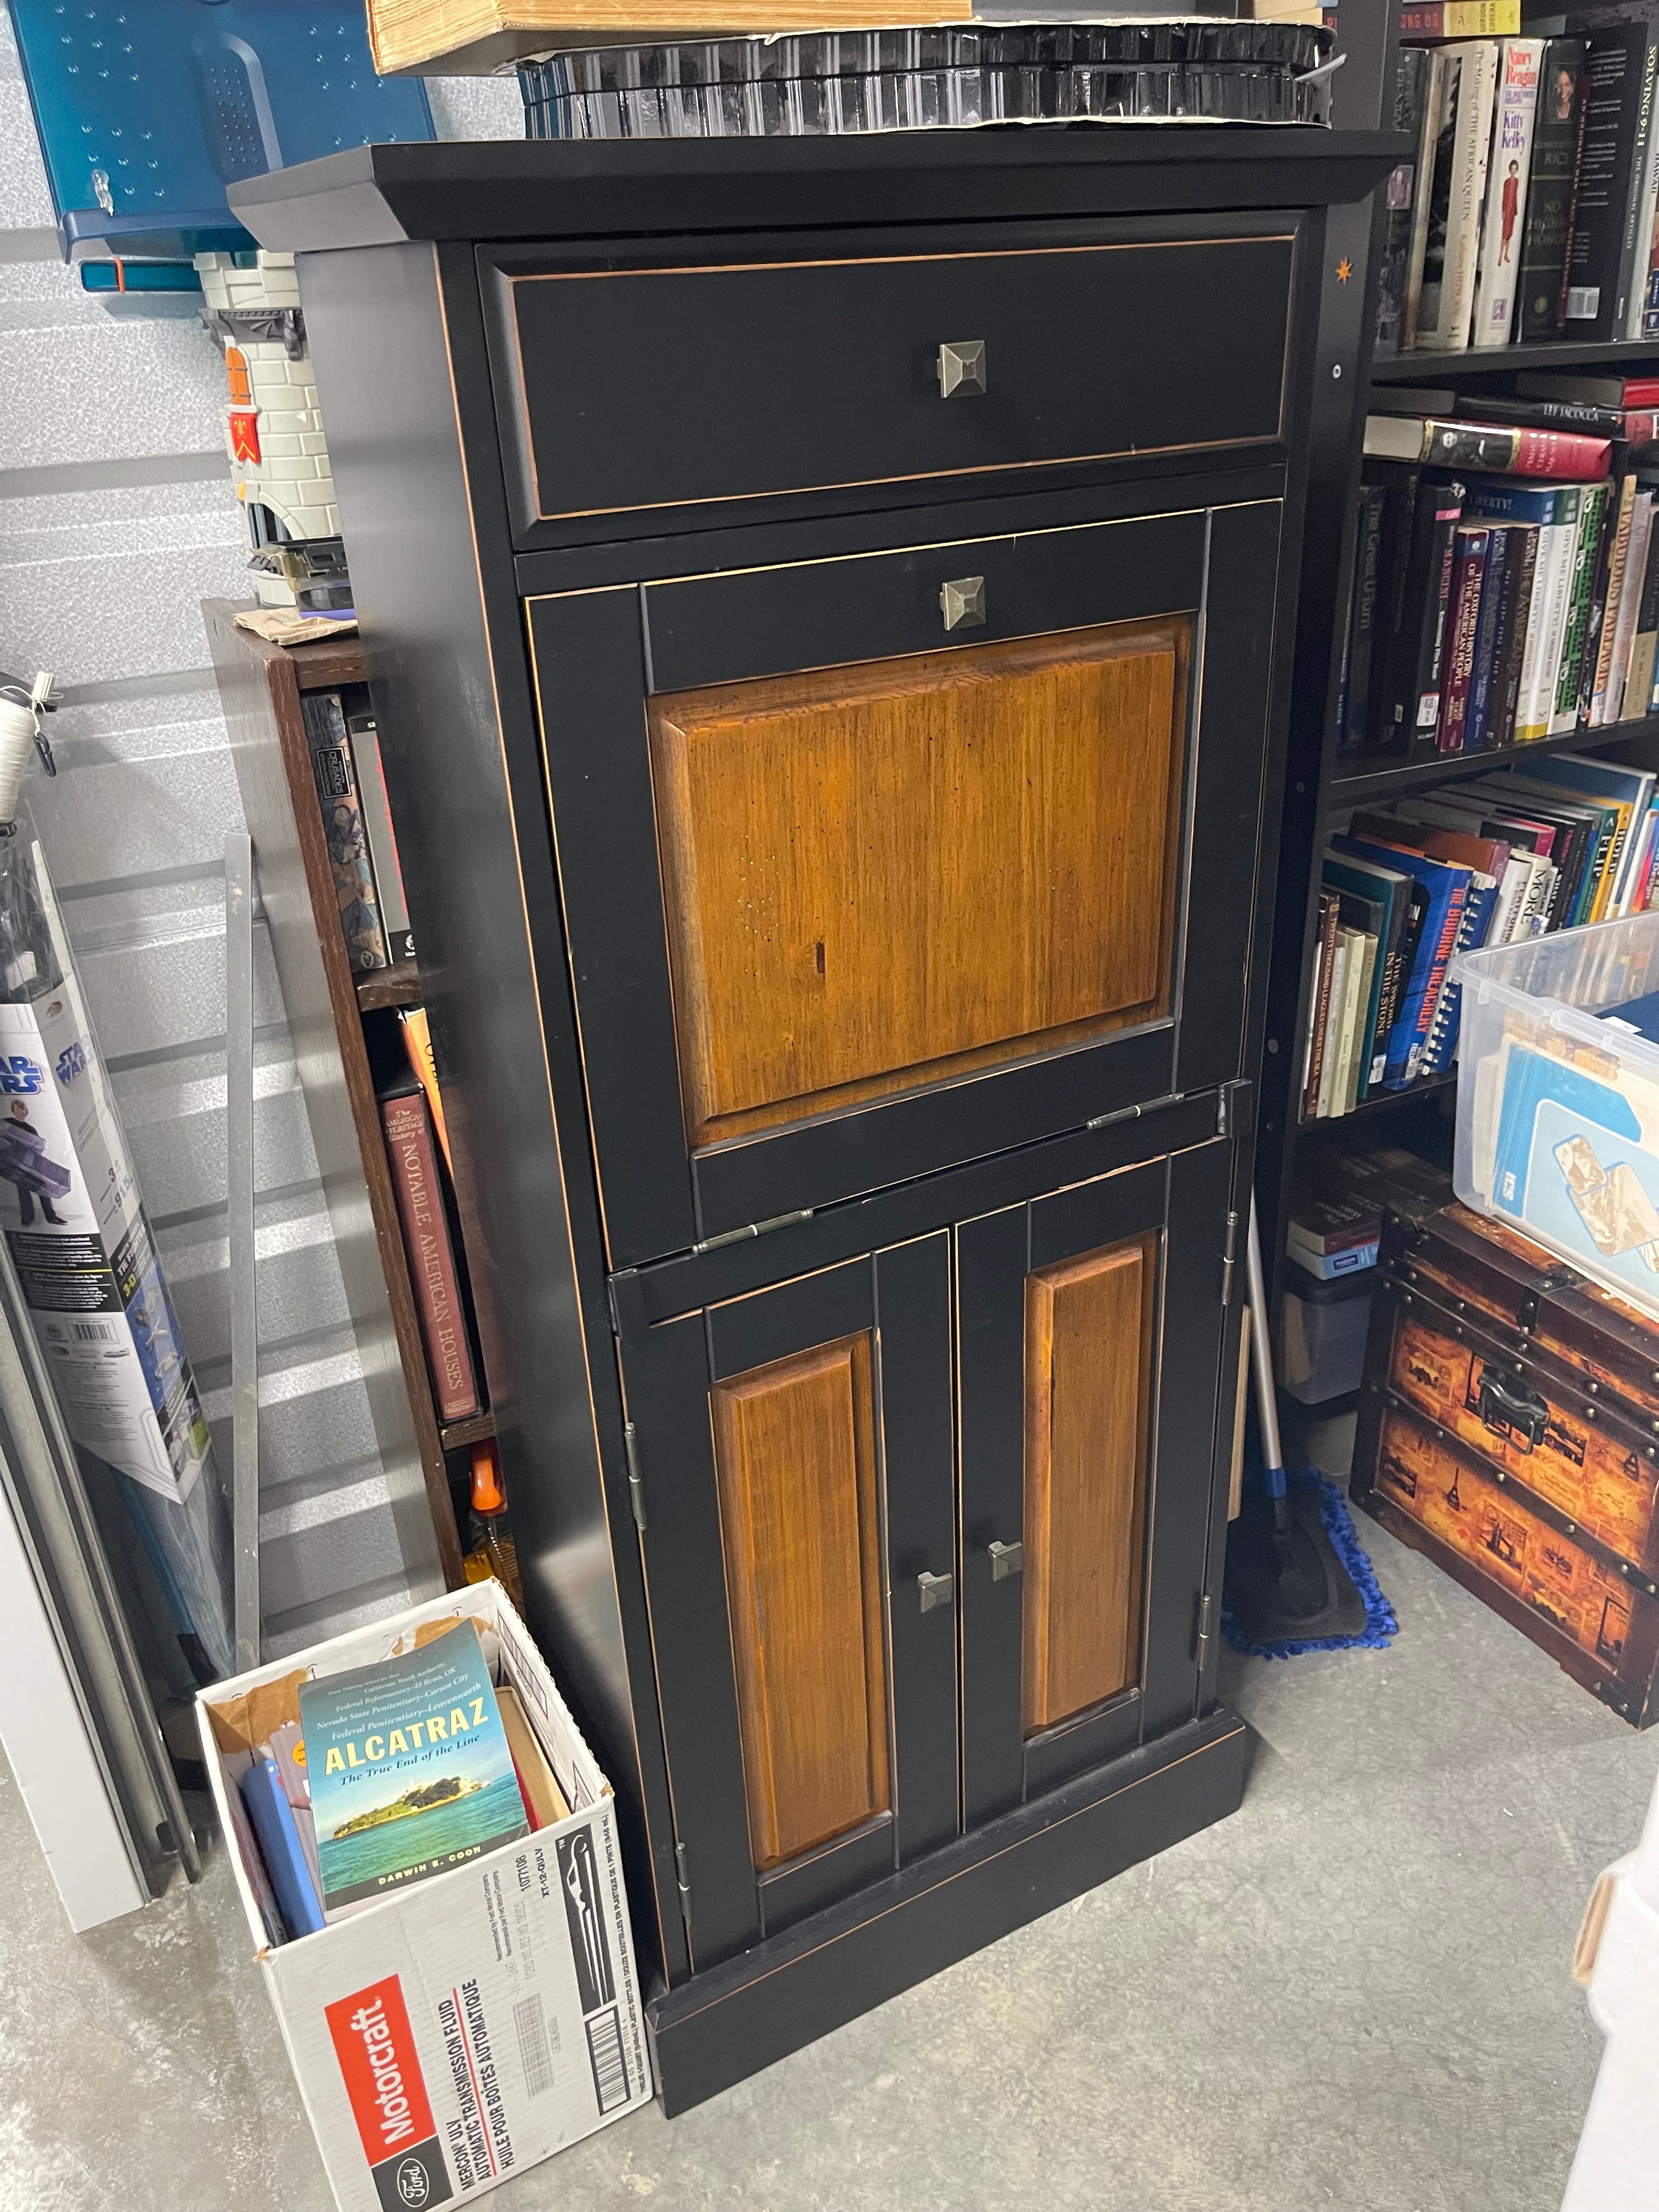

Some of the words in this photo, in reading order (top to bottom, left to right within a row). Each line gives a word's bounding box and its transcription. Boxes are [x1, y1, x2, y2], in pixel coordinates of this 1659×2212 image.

[1475, 48, 1483, 66] The
[1508, 46, 1531, 71] Nancy
[1470, 68, 1482, 100] Making
[1505, 65, 1537, 88] Reagan
[1641, 44, 1657, 116] SOLVING
[1469, 112, 1478, 136] THE
[1471, 101, 1480, 110] of
[1503, 110, 1524, 129] Kitty
[1637, 117, 1647, 147] 9-11
[1465, 138, 1476, 183] AFRICAN
[1459, 184, 1472, 220] QUEEN
[1630, 173, 1640, 211] ORIGINAL
[1562, 529, 1572, 557] GIVE
[1609, 508, 1632, 601] FABULOUS
[1438, 547, 1453, 599] MANCINI
[1472, 572, 1482, 592] THE
[1559, 558, 1568, 577] ME
[1464, 580, 1474, 600] THE
[1458, 601, 1471, 650] AMERICAN
[1468, 592, 1480, 635] OXFORD
[1478, 592, 1499, 674] AMERICANS
[1509, 594, 1530, 675] AMERICANS
[1596, 602, 1618, 694] FALLACIES
[1453, 651, 1465, 687] PEOPLE
[1462, 636, 1474, 677] HISTORY
[328, 750, 343, 794] CRUSADES
[1449, 886, 1465, 908] THE
[1521, 868, 1546, 927] MORE
[1327, 917, 1337, 948] TWENTY
[1434, 906, 1462, 964] BOURNE
[1323, 948, 1333, 989] THOUSAND
[1385, 951, 1395, 968] IN
[1391, 957, 1402, 983] THE
[1381, 969, 1393, 996] THE
[1415, 963, 1447, 1035] TREACHERY
[1373, 995, 1390, 1039] STONE
[1383, 983, 1399, 1030] SWORD
[394, 1108, 411, 1118] The
[117, 1259, 128, 1276] TIE
[400, 1142, 433, 1227] NOTABLE
[418, 1231, 452, 1323] AMERICAN
[437, 1327, 465, 1391] HOUSES
[335, 1698, 364, 1712] Federal
[442, 1665, 458, 1677] OK
[362, 1679, 397, 1694] California
[397, 1673, 416, 1684] Youth
[414, 1661, 447, 1678] Authority
[315, 1714, 348, 1730] Nevada
[348, 1708, 371, 1721] State
[452, 1672, 471, 1686] City
[324, 1696, 488, 1775] ALCATRAZ
[330, 1723, 366, 1741] Federal
[339, 1771, 364, 1787] The
[364, 1762, 394, 1779] True
[394, 1754, 419, 1769] End
[420, 1748, 436, 1763] of
[433, 1741, 454, 1757] the
[454, 1733, 482, 1750] Line
[557, 1838, 566, 1849] TM
[377, 1862, 428, 1887] DARWIN
[431, 1857, 444, 1868] E.
[447, 1844, 482, 1863] COON
[514, 1854, 532, 1892] 1077108
[533, 1847, 551, 1898] XT-12-QULV
[487, 1910, 495, 1922] Ford
[498, 1906, 506, 1918] Ford
[437, 1998, 460, 2036] FLUID
[460, 1977, 493, 2064] AUTOMATIQUE
[350, 2004, 415, 2146] Motorcraft
[445, 2034, 479, 2122] TRANSMISSION
[475, 2062, 502, 2107] BOÎTES
[445, 2118, 465, 2142] ULV
[487, 2103, 509, 2137] POUR
[464, 2118, 492, 2181] AUTOMATIC
[495, 2134, 515, 2169] HUILE
[399, 2164, 426, 2199] Ford
